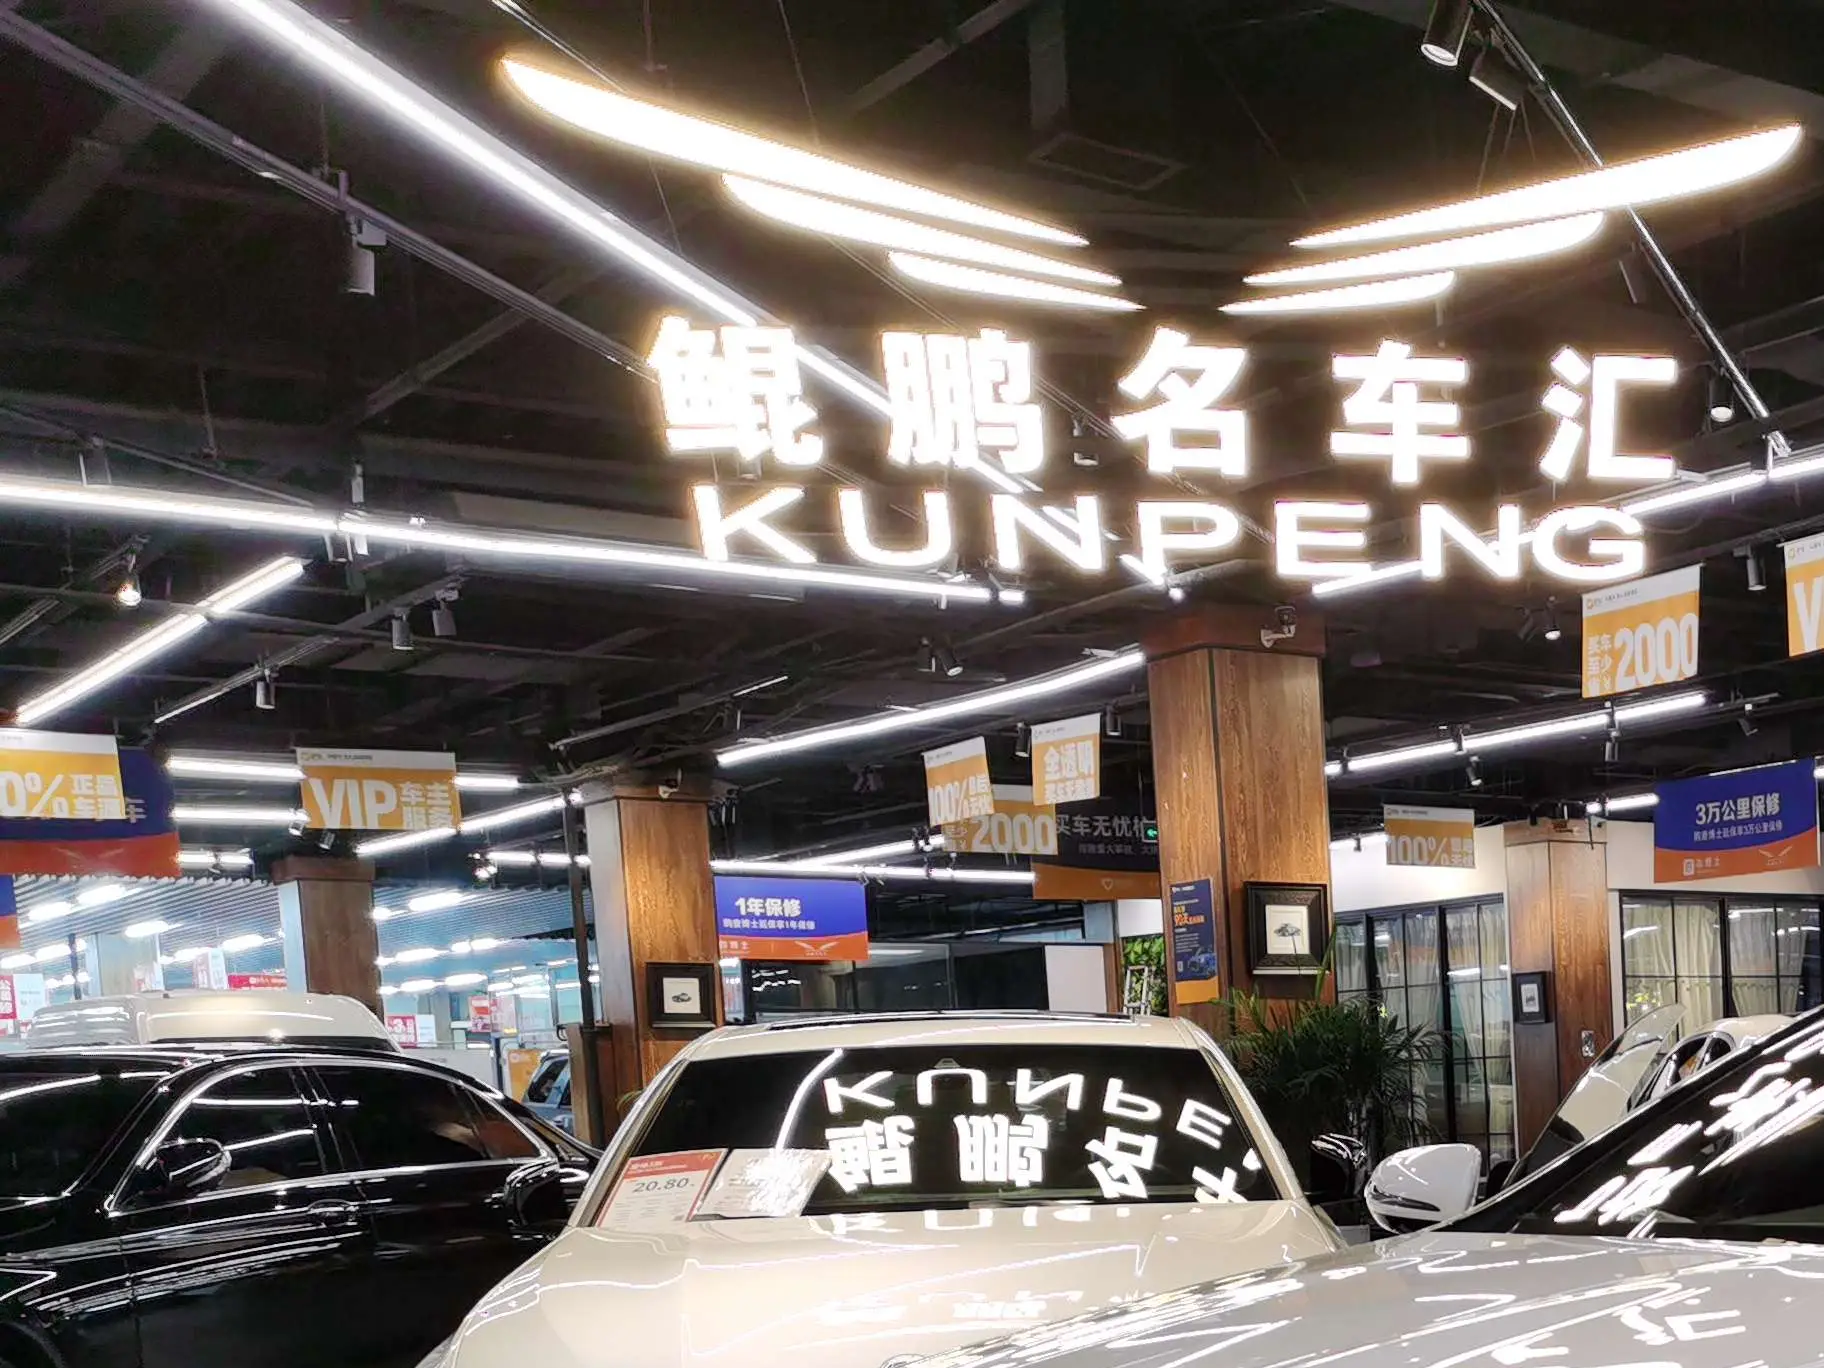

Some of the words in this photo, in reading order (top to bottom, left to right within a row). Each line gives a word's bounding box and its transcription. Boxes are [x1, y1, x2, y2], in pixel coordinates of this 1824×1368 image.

[646, 313, 1678, 484] 鲲鹏名车汇
[690, 484, 1647, 582] KUNPENG
[1614, 612, 1699, 692] 2000
[308, 778, 397, 829] VIP
[1695, 792, 1781, 825] 3万公里保修
[971, 813, 1056, 853] 2000
[1387, 835, 1450, 866] 100%
[735, 897, 802, 917] 1年保修
